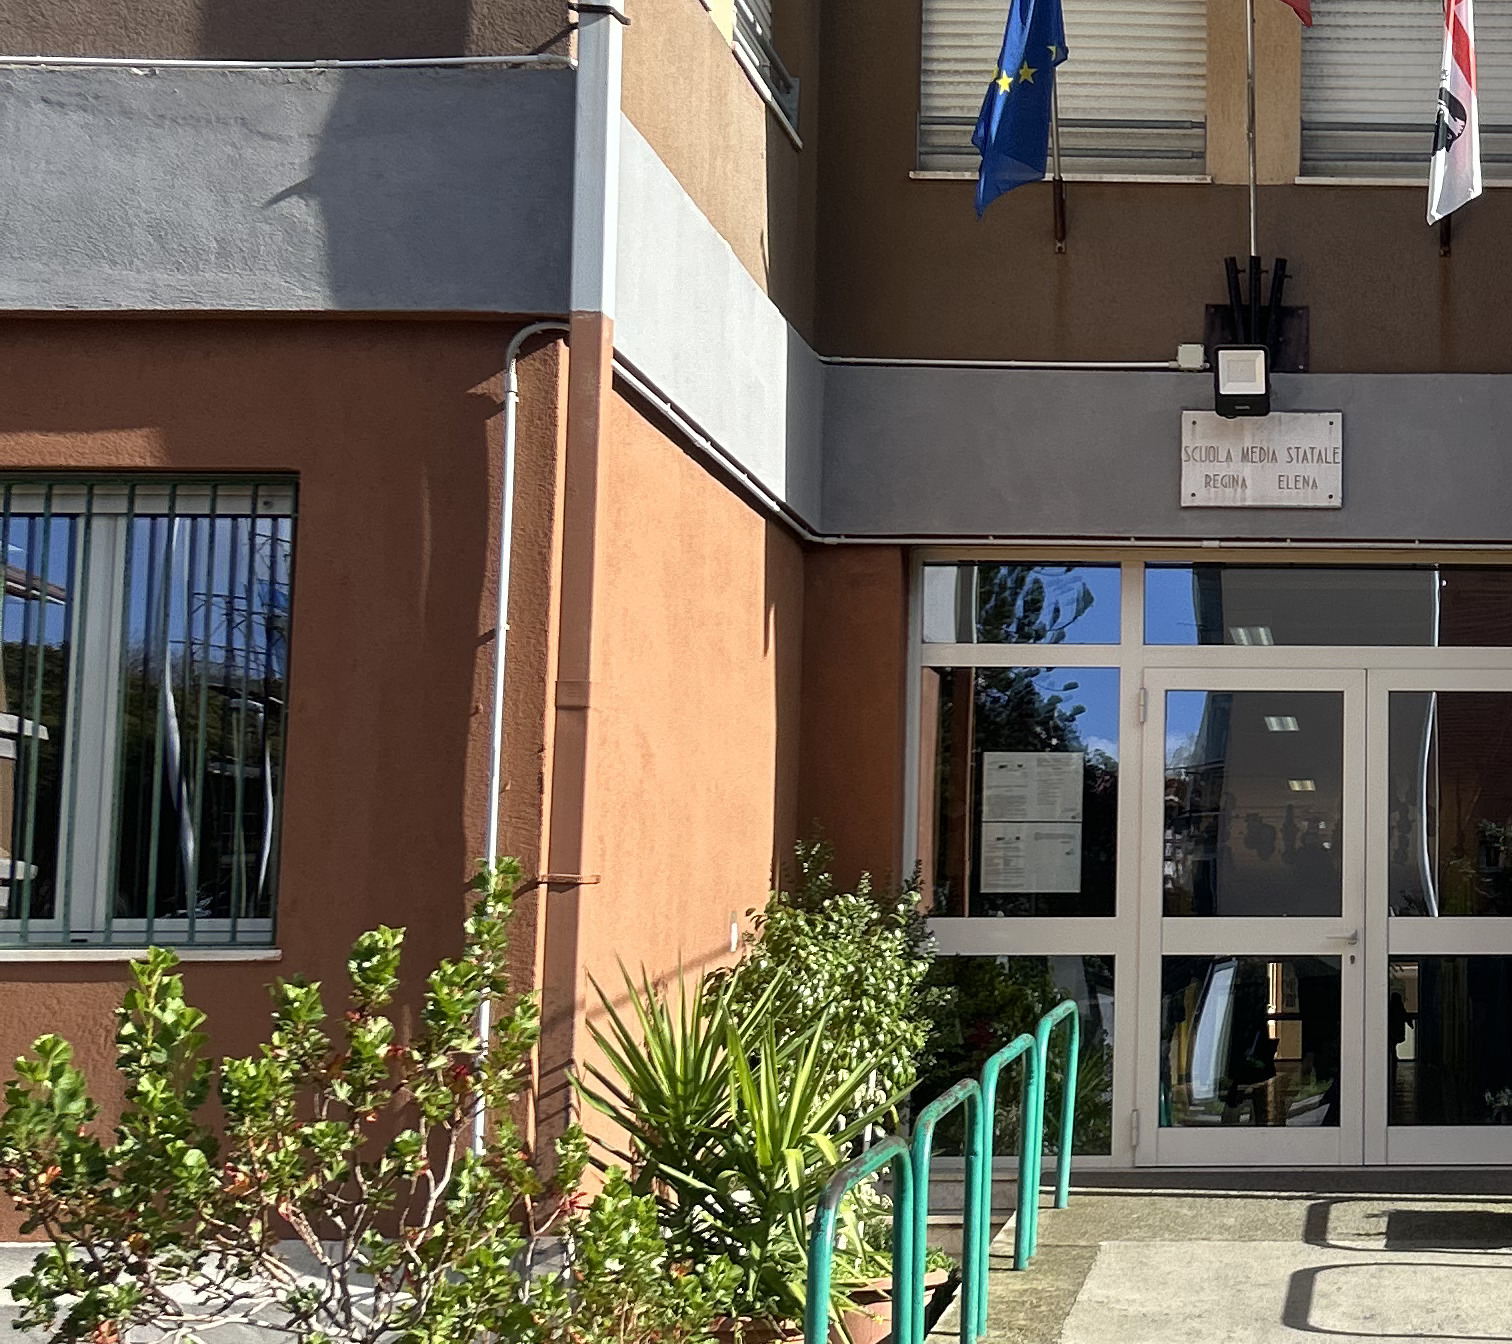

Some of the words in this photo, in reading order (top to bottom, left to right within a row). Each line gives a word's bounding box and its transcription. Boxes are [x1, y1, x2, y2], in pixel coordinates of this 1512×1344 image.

[1183, 445, 1233, 463] SCUOLA
[1240, 446, 1278, 464] MEDIA
[1286, 446, 1341, 465] STATALE
[1204, 473, 1248, 489] REGINA
[1278, 474, 1318, 490] ELENA
